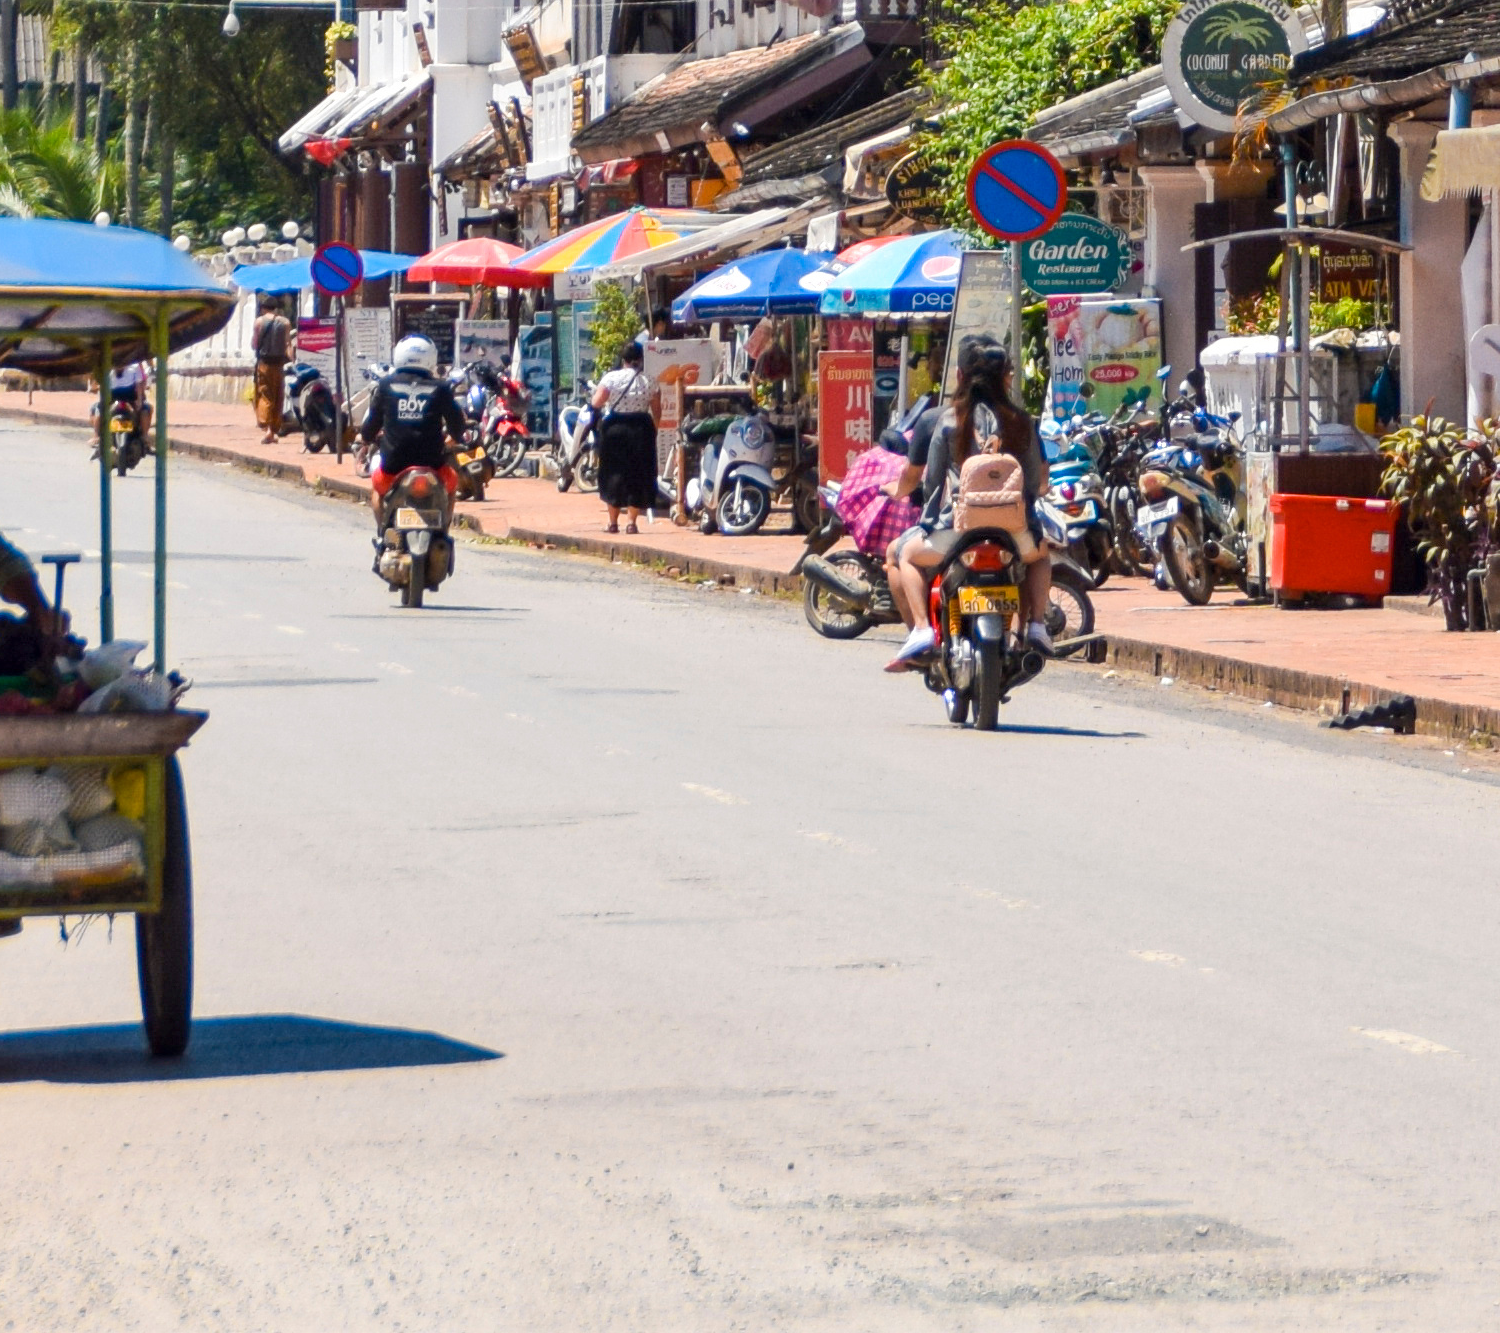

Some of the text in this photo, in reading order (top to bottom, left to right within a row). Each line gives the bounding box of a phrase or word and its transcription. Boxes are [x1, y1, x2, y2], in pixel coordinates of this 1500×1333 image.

[1187, 54, 1229, 70] COCONUT
[1028, 236, 1108, 260] Garden
[1038, 263, 1101, 276] Restaurant
[1324, 280, 1352, 298] ATM
[911, 292, 953, 310] pep
[1053, 337, 1076, 356] Ice
[1054, 365, 1084, 382] Hom
[398, 399, 427, 412] BOY
